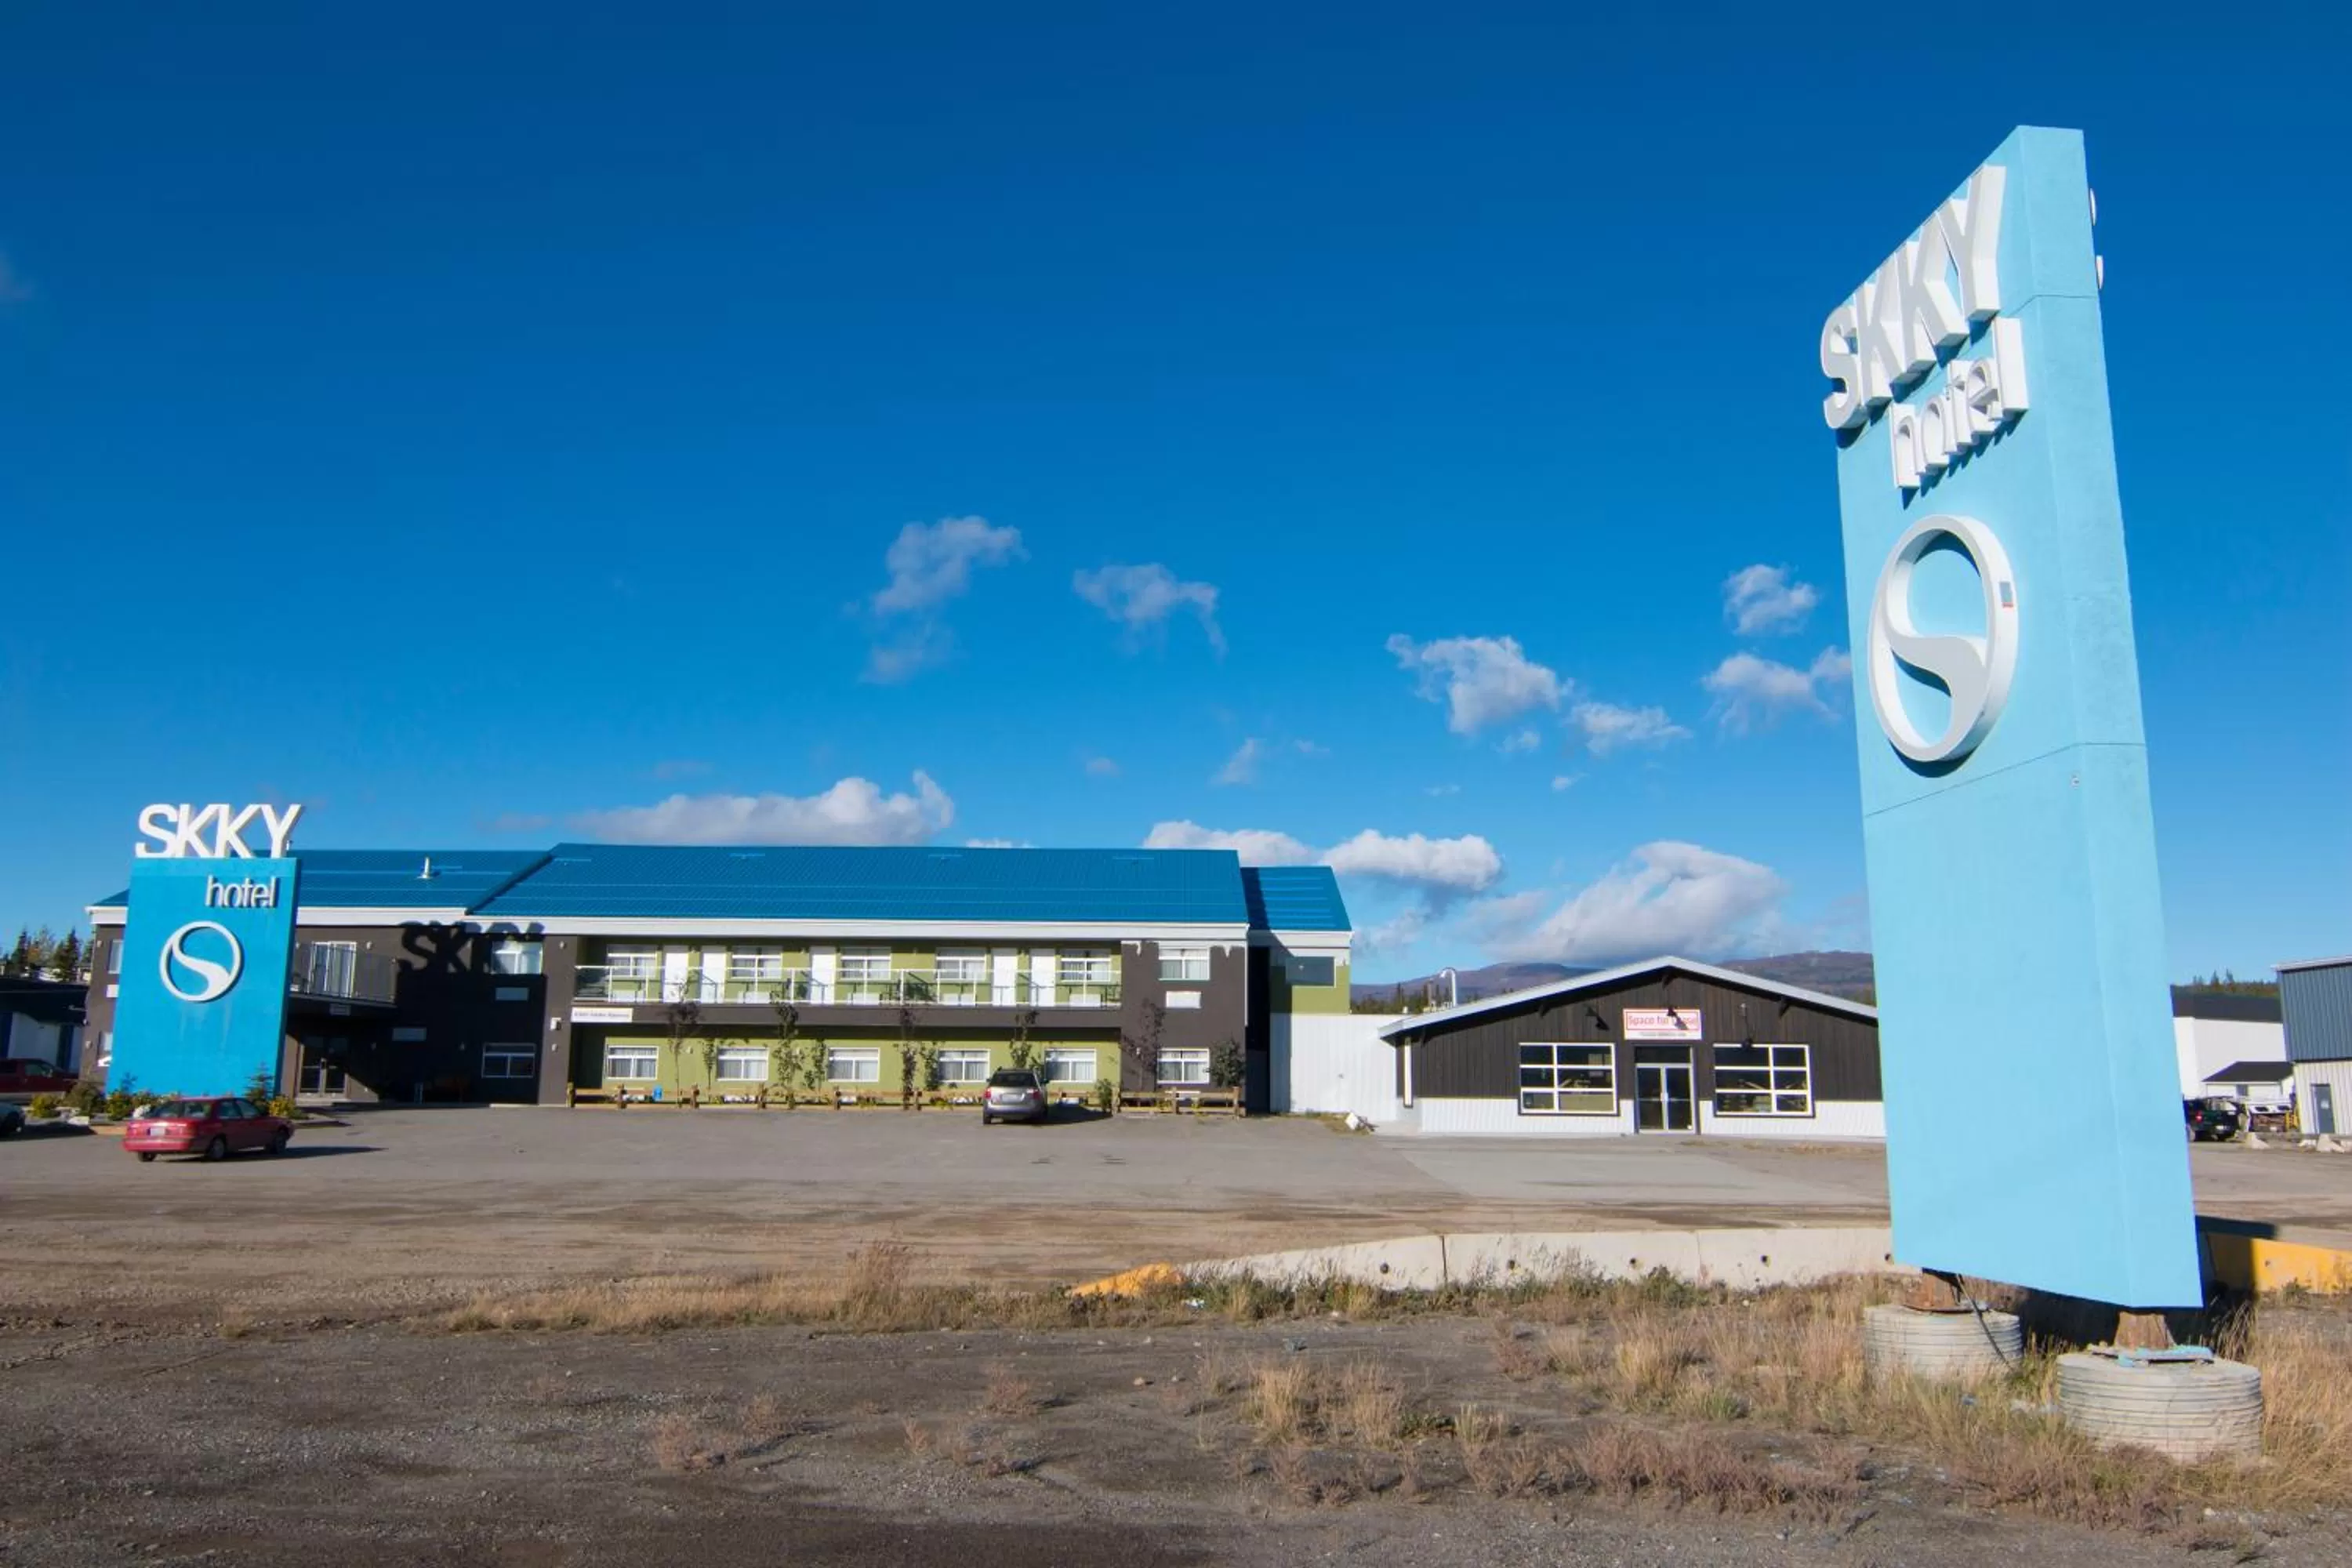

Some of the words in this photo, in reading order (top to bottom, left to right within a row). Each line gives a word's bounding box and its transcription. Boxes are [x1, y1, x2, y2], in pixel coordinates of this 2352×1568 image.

[1820, 165, 2006, 428] SKKY
[1889, 317, 2029, 488] hotel
[135, 803, 303, 858] SKKY
[205, 874, 278, 908] hotel
[1628, 1014, 1654, 1026] Space
